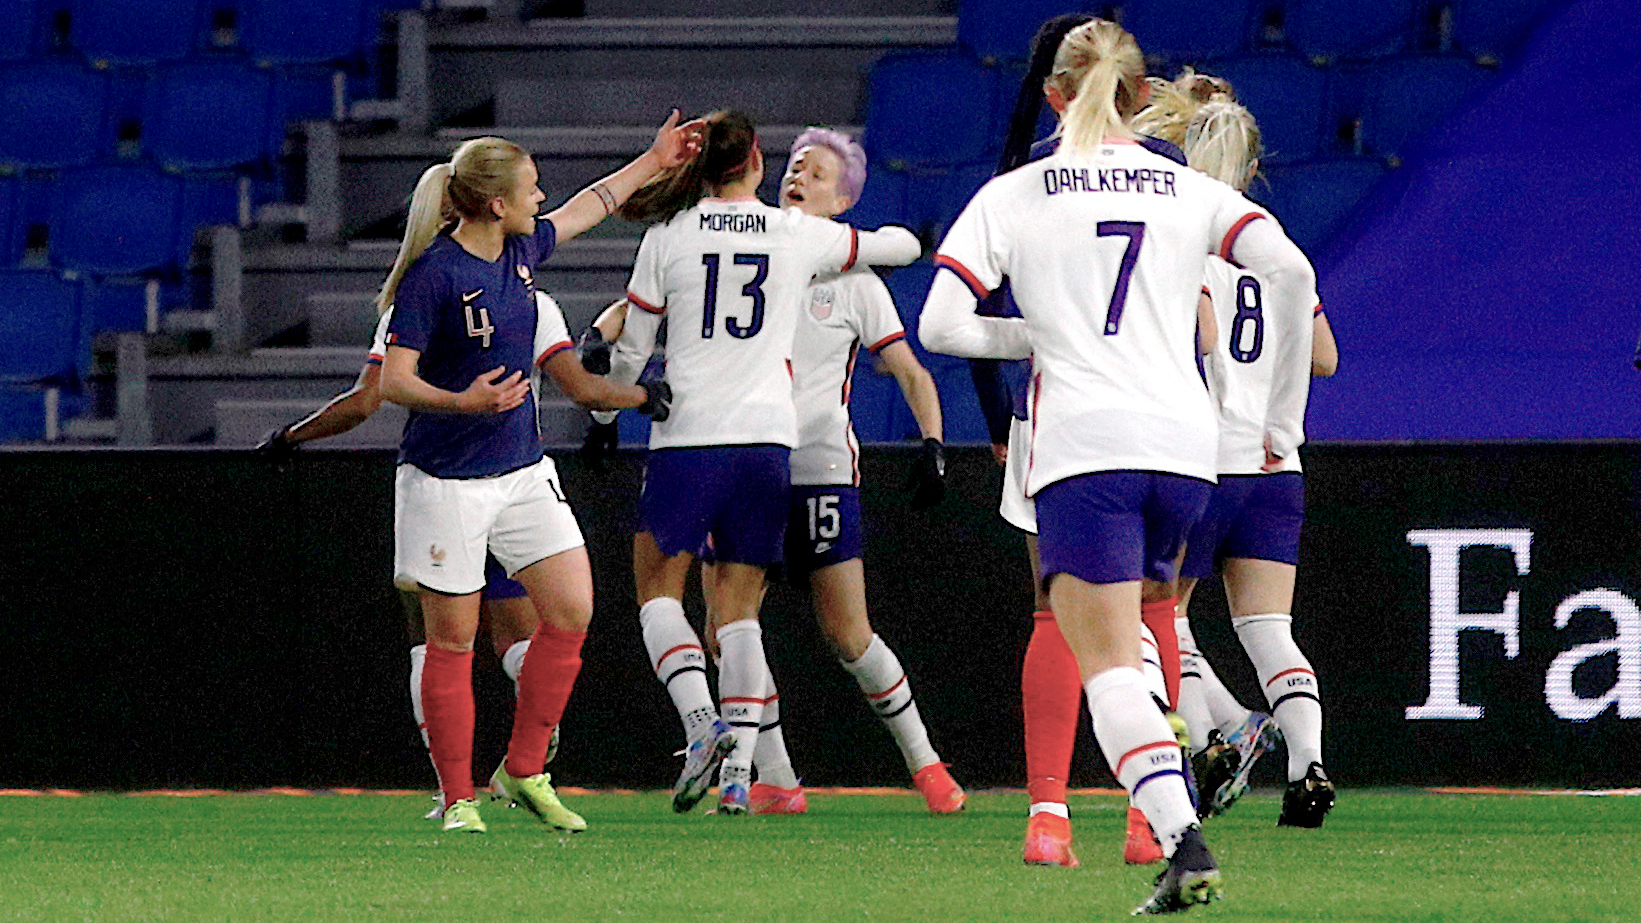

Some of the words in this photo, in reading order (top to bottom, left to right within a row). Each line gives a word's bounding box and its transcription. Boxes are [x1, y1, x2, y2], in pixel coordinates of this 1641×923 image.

[1044, 168, 1177, 197] DAHLKEMPER
[699, 213, 766, 233] MORGAN
[701, 253, 769, 339] 13
[1096, 220, 1146, 336] 7
[464, 305, 495, 348] 4
[1229, 275, 1264, 363] 8
[806, 495, 841, 541] 15
[1404, 527, 1641, 723] Fa
[1287, 678, 1312, 687] USA
[727, 707, 748, 716] USA
[1150, 753, 1178, 766] USA
